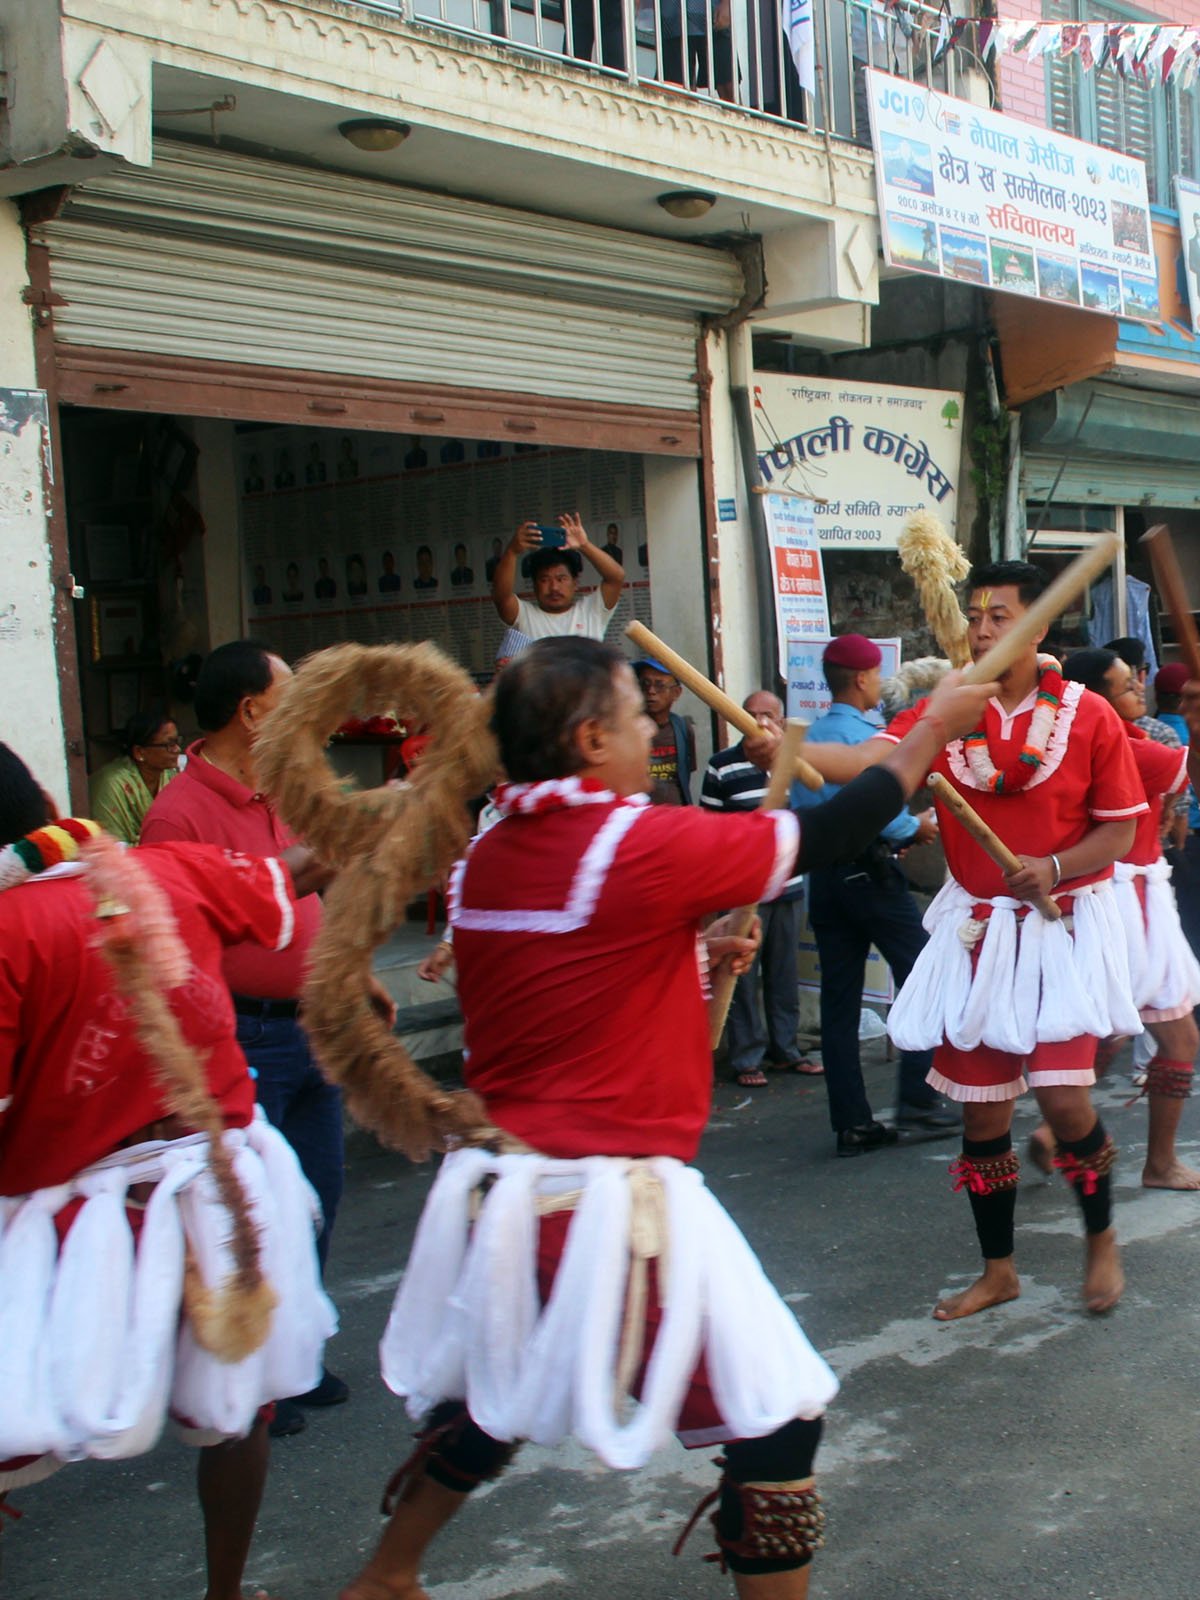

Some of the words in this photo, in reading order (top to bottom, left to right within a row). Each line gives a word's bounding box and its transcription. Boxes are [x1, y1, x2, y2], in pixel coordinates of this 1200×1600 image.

[879, 89, 909, 116] JCI
[937, 145, 970, 184] क्षेत्र
[968, 117, 1020, 160] नेपाल
[1024, 136, 1076, 177] जेसीज
[1108, 162, 1130, 183] JCI
[985, 203, 1075, 247] सचिवालय
[862, 425, 955, 503] कांग्रेस
[854, 530, 882, 542] २००३
